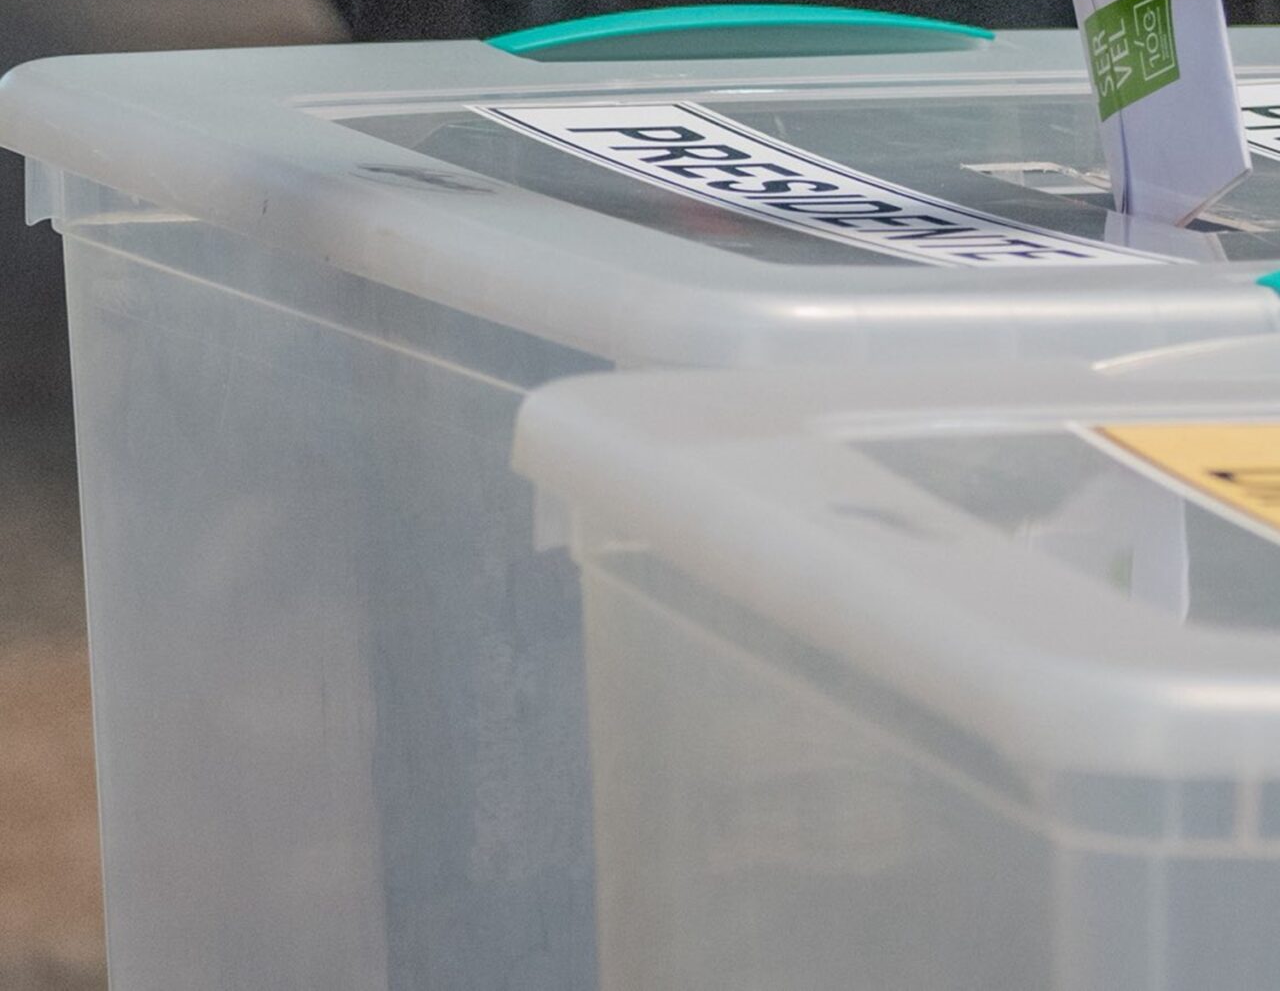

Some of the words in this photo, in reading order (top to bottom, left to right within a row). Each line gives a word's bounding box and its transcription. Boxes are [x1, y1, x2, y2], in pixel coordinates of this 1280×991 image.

[1092, 29, 1115, 97] SER
[1108, 18, 1132, 89] VEL
[566, 125, 1097, 260] PRESIDENTE
